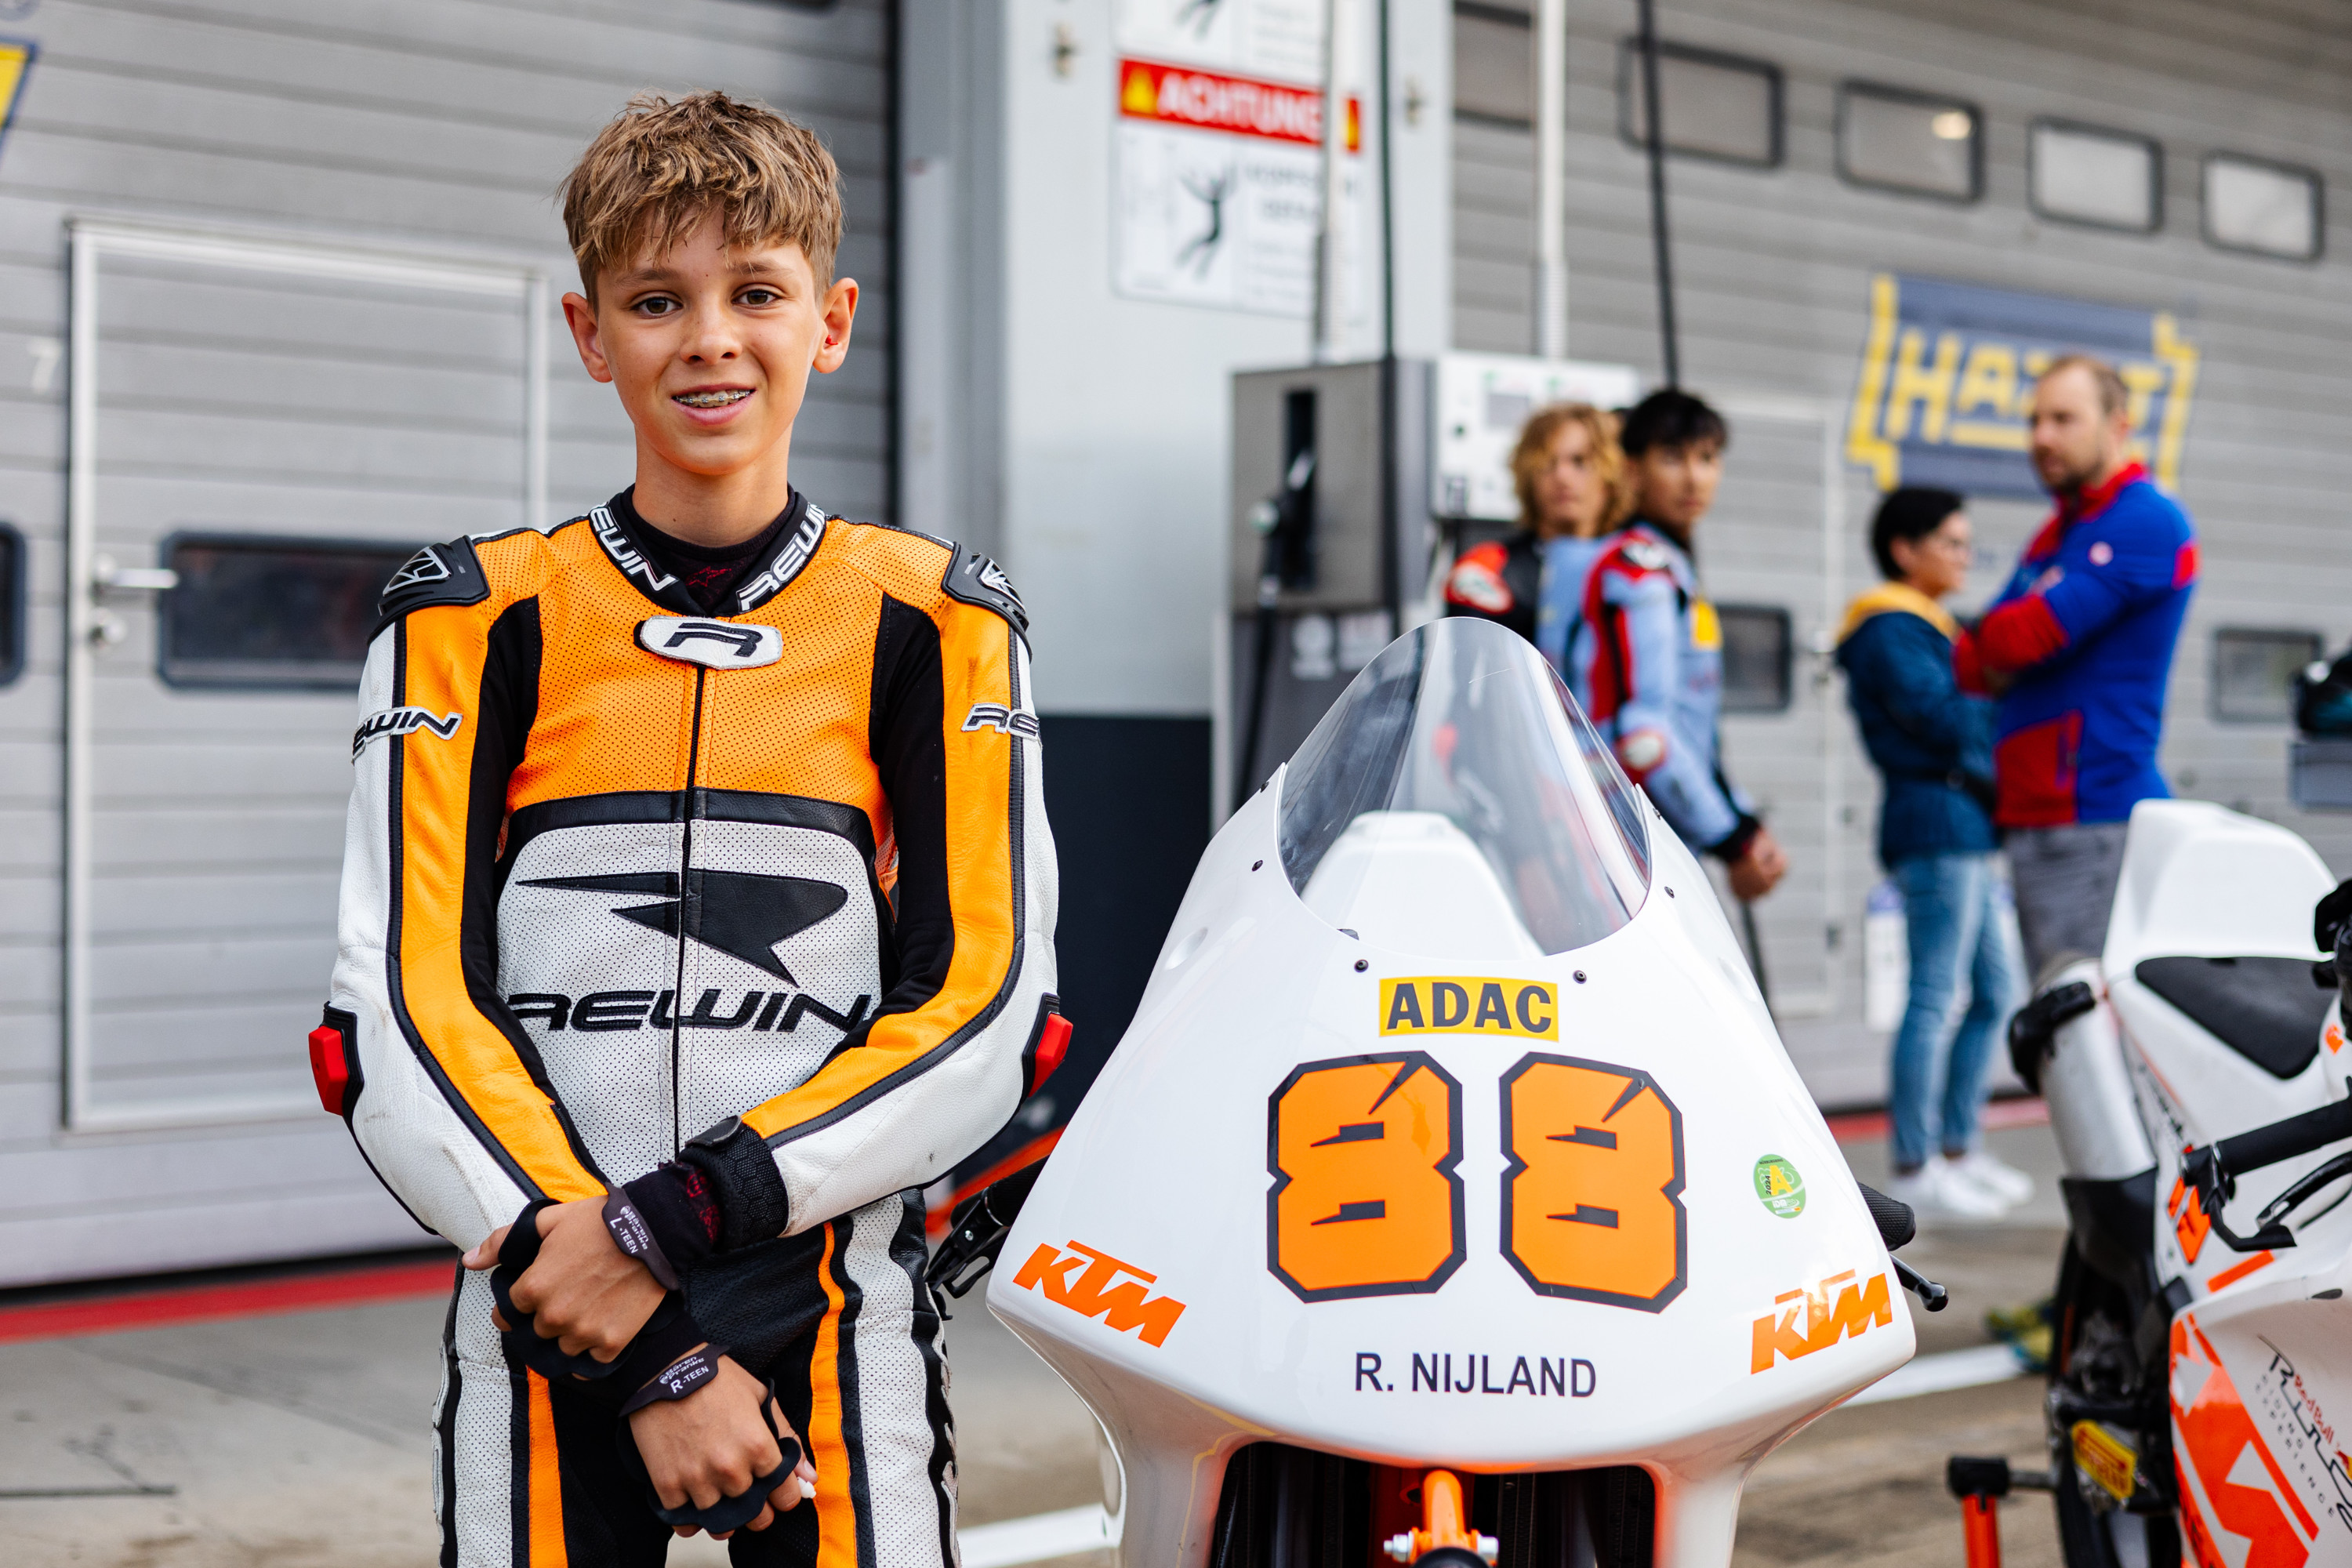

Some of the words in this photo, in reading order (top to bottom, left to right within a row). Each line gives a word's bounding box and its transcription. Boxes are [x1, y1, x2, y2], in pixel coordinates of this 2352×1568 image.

[26, 337, 62, 393] 7
[1886, 328, 2162, 437] HAT
[590, 502, 679, 592] EWIN
[353, 710, 459, 756] EWIN
[967, 707, 1039, 736] RE
[508, 989, 871, 1033] REWIN
[1387, 982, 1552, 1033] ADAC
[1267, 1051, 1687, 1314] 88
[1769, 1165, 1793, 1196] A
[1012, 1240, 1186, 1348] KTM
[1751, 1268, 1893, 1375] KTM
[1356, 1352, 1393, 1392] R.
[1412, 1353, 1596, 1397] NIJLAND
